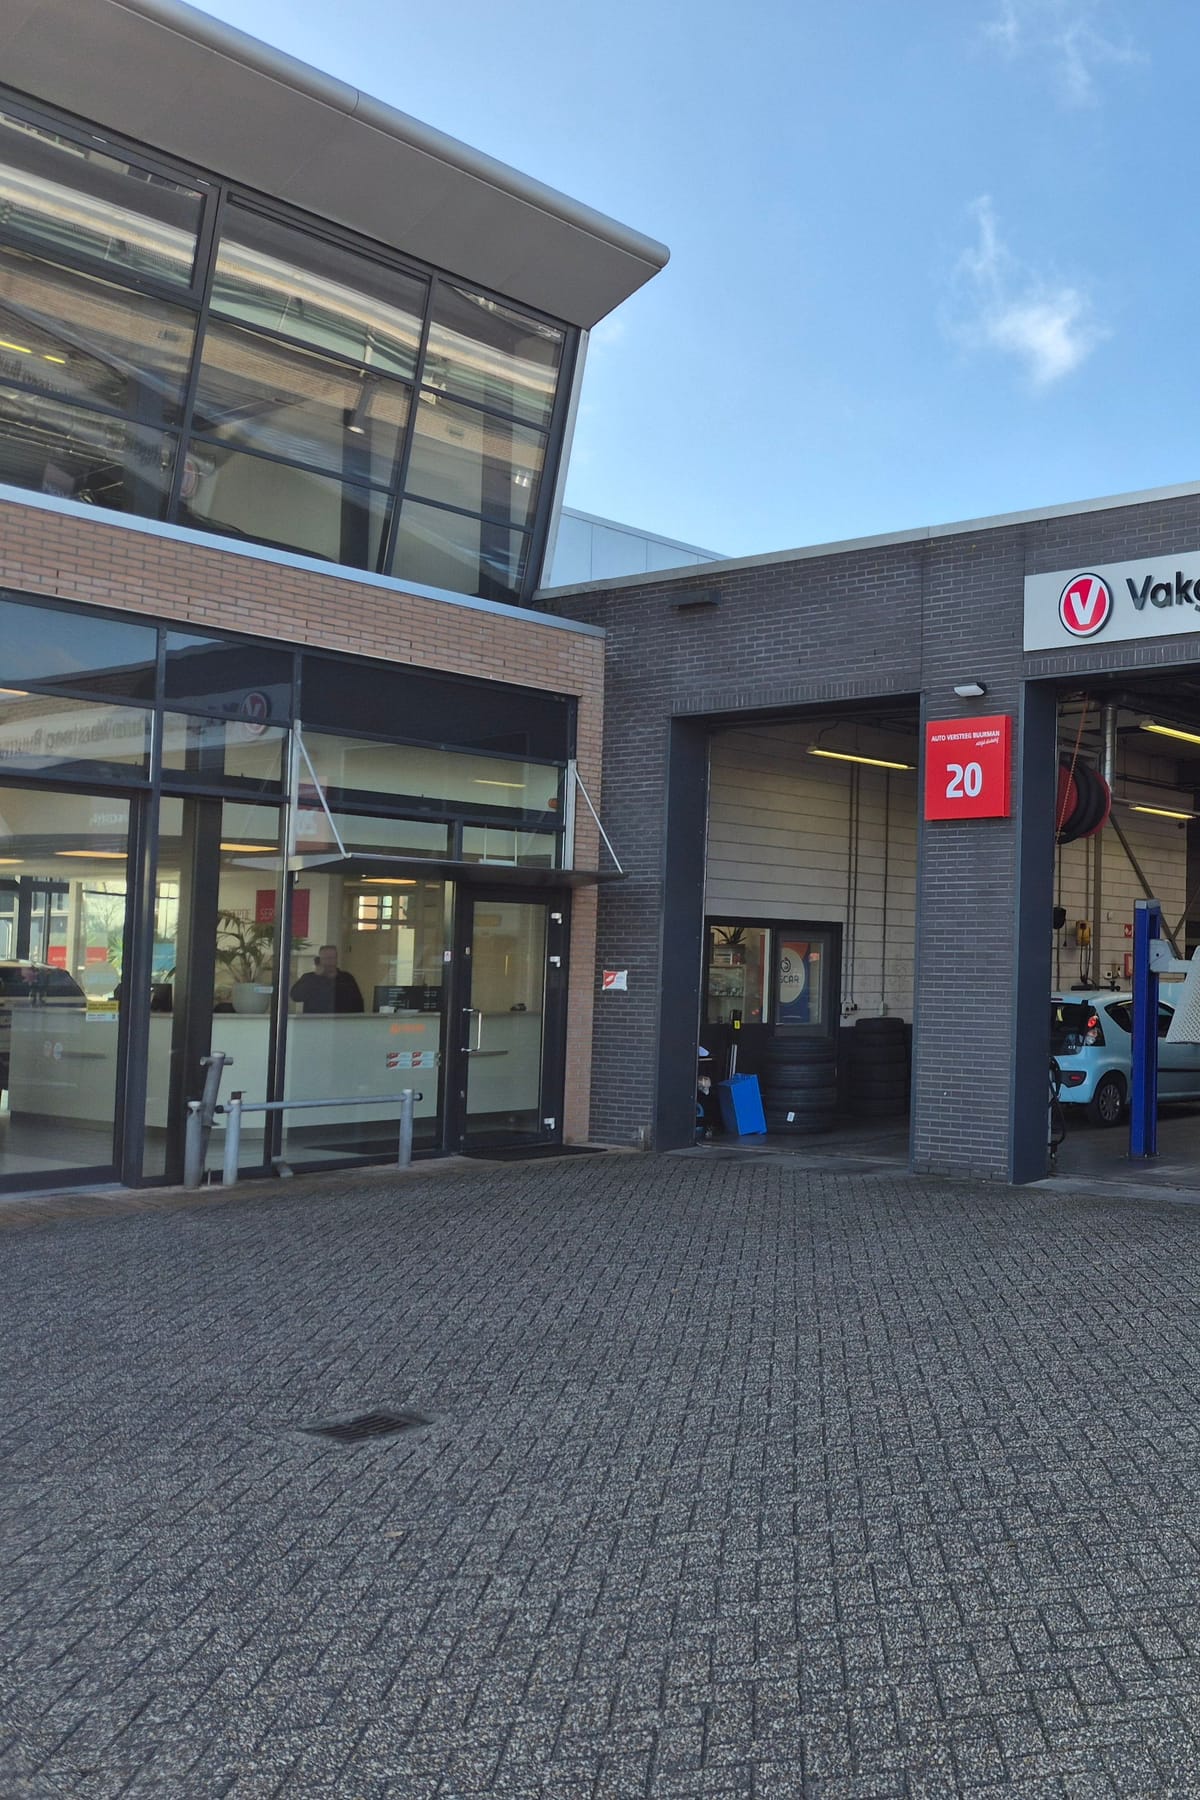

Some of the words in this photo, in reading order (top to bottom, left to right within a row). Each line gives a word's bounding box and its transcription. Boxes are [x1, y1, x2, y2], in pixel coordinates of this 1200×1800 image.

[947, 732, 972, 741] VERSTEEG
[973, 730, 1000, 738] BUURMAN
[946, 762, 983, 798] 20
